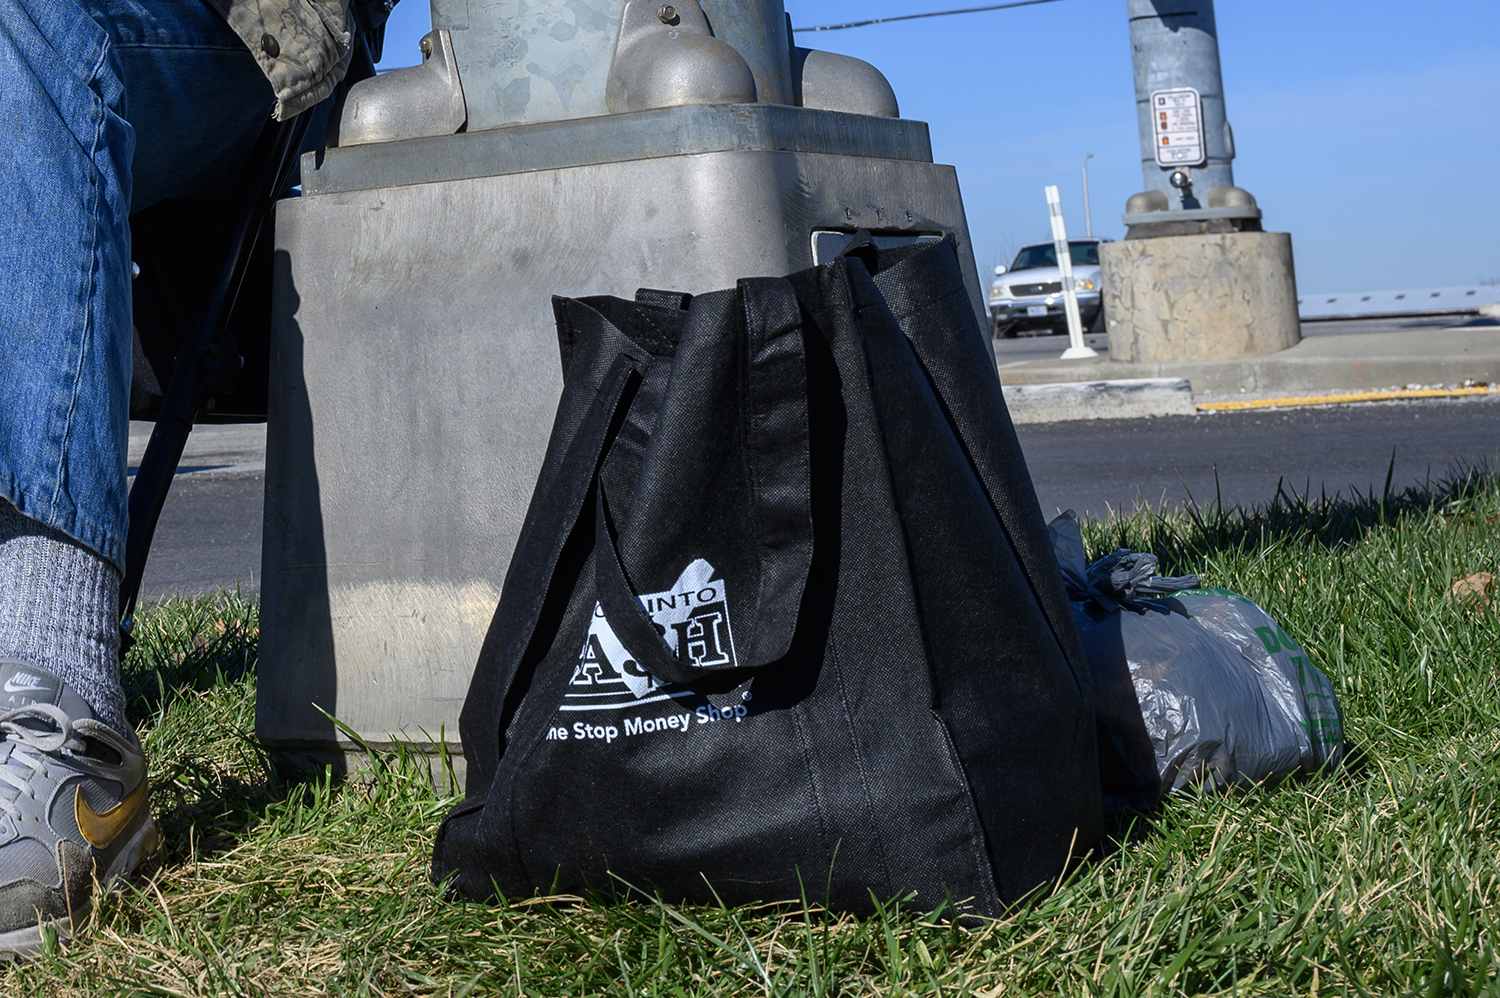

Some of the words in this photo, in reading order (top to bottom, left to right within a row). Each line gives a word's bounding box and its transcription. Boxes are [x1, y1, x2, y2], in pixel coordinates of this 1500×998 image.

[647, 587, 717, 614] INTO
[11, 671, 41, 688] NIKE
[546, 726, 569, 740] ne
[573, 721, 619, 744] Stop
[624, 712, 691, 737] Money
[696, 703, 748, 724] Shop
